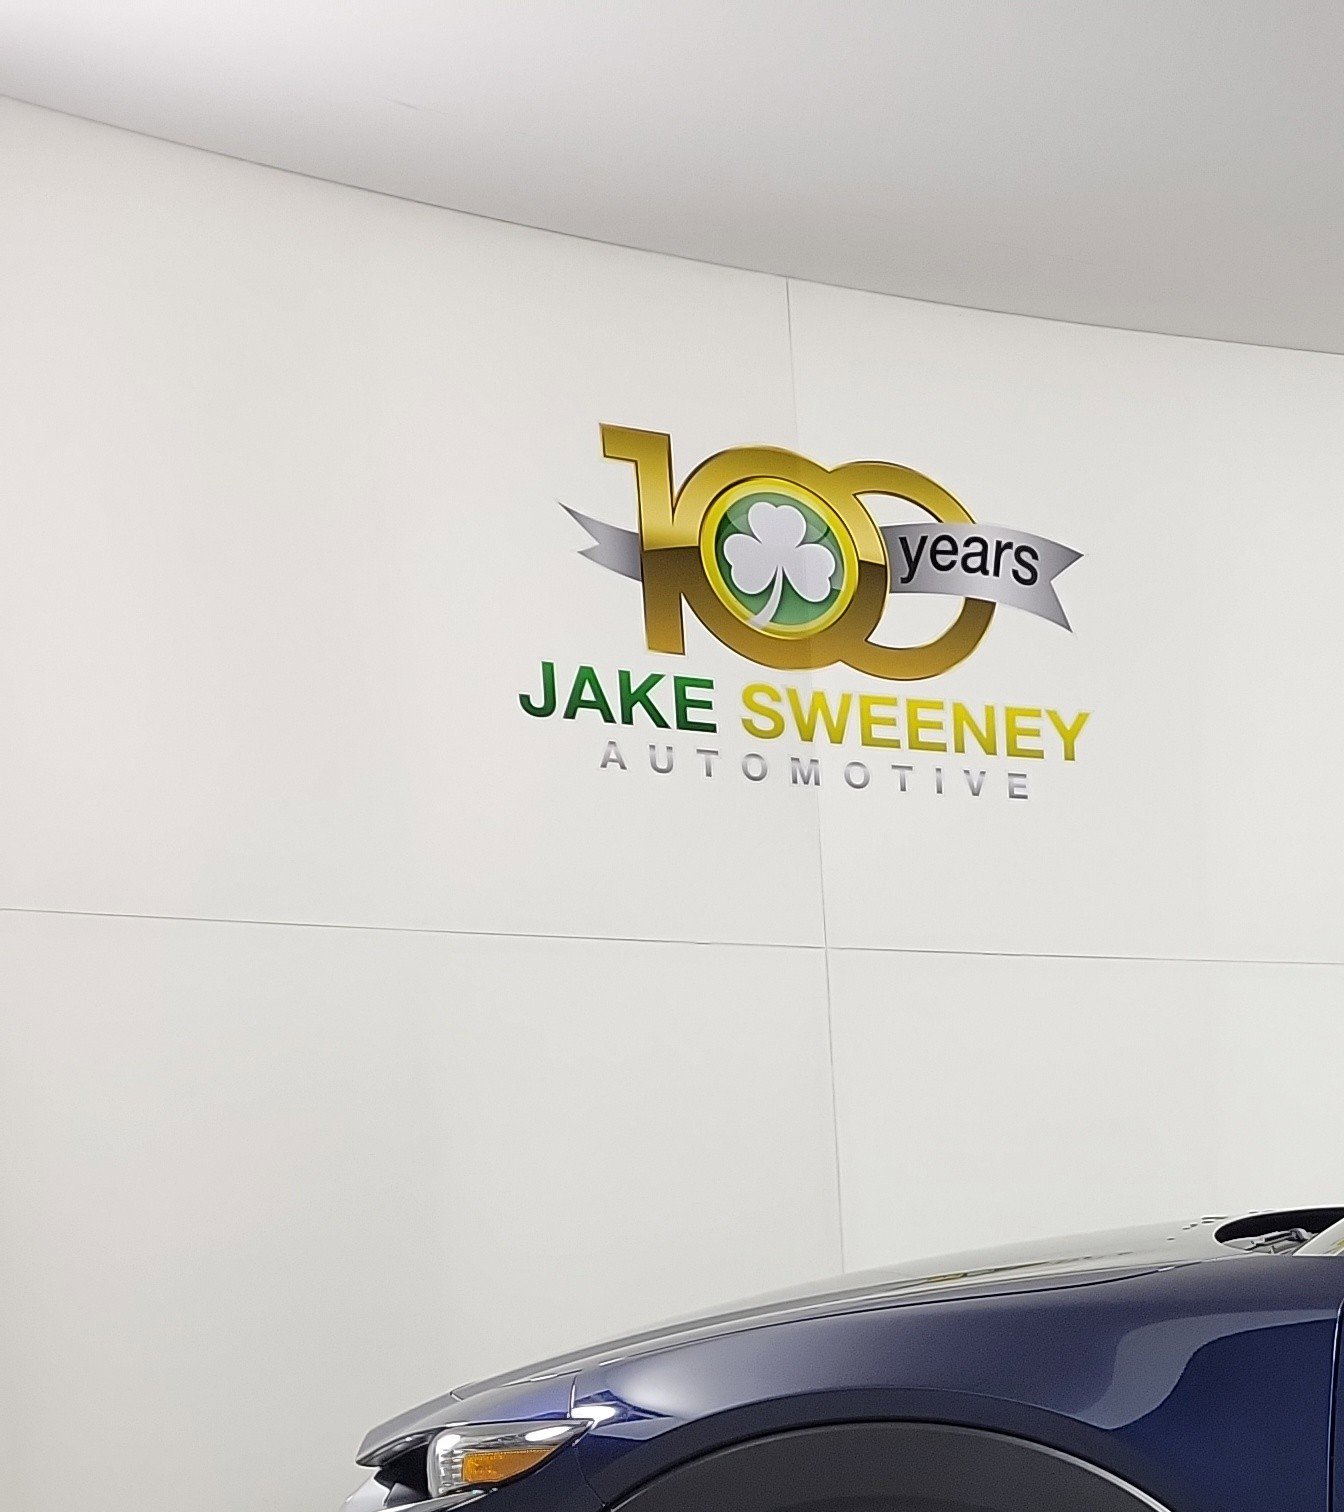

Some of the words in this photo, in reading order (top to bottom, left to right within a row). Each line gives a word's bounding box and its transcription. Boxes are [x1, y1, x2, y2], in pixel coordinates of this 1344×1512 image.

[898, 532, 1041, 587] years
[518, 661, 718, 735] JAKE
[741, 682, 1090, 762] SWEENEY
[600, 740, 1029, 800] AUTOMOTIVE
